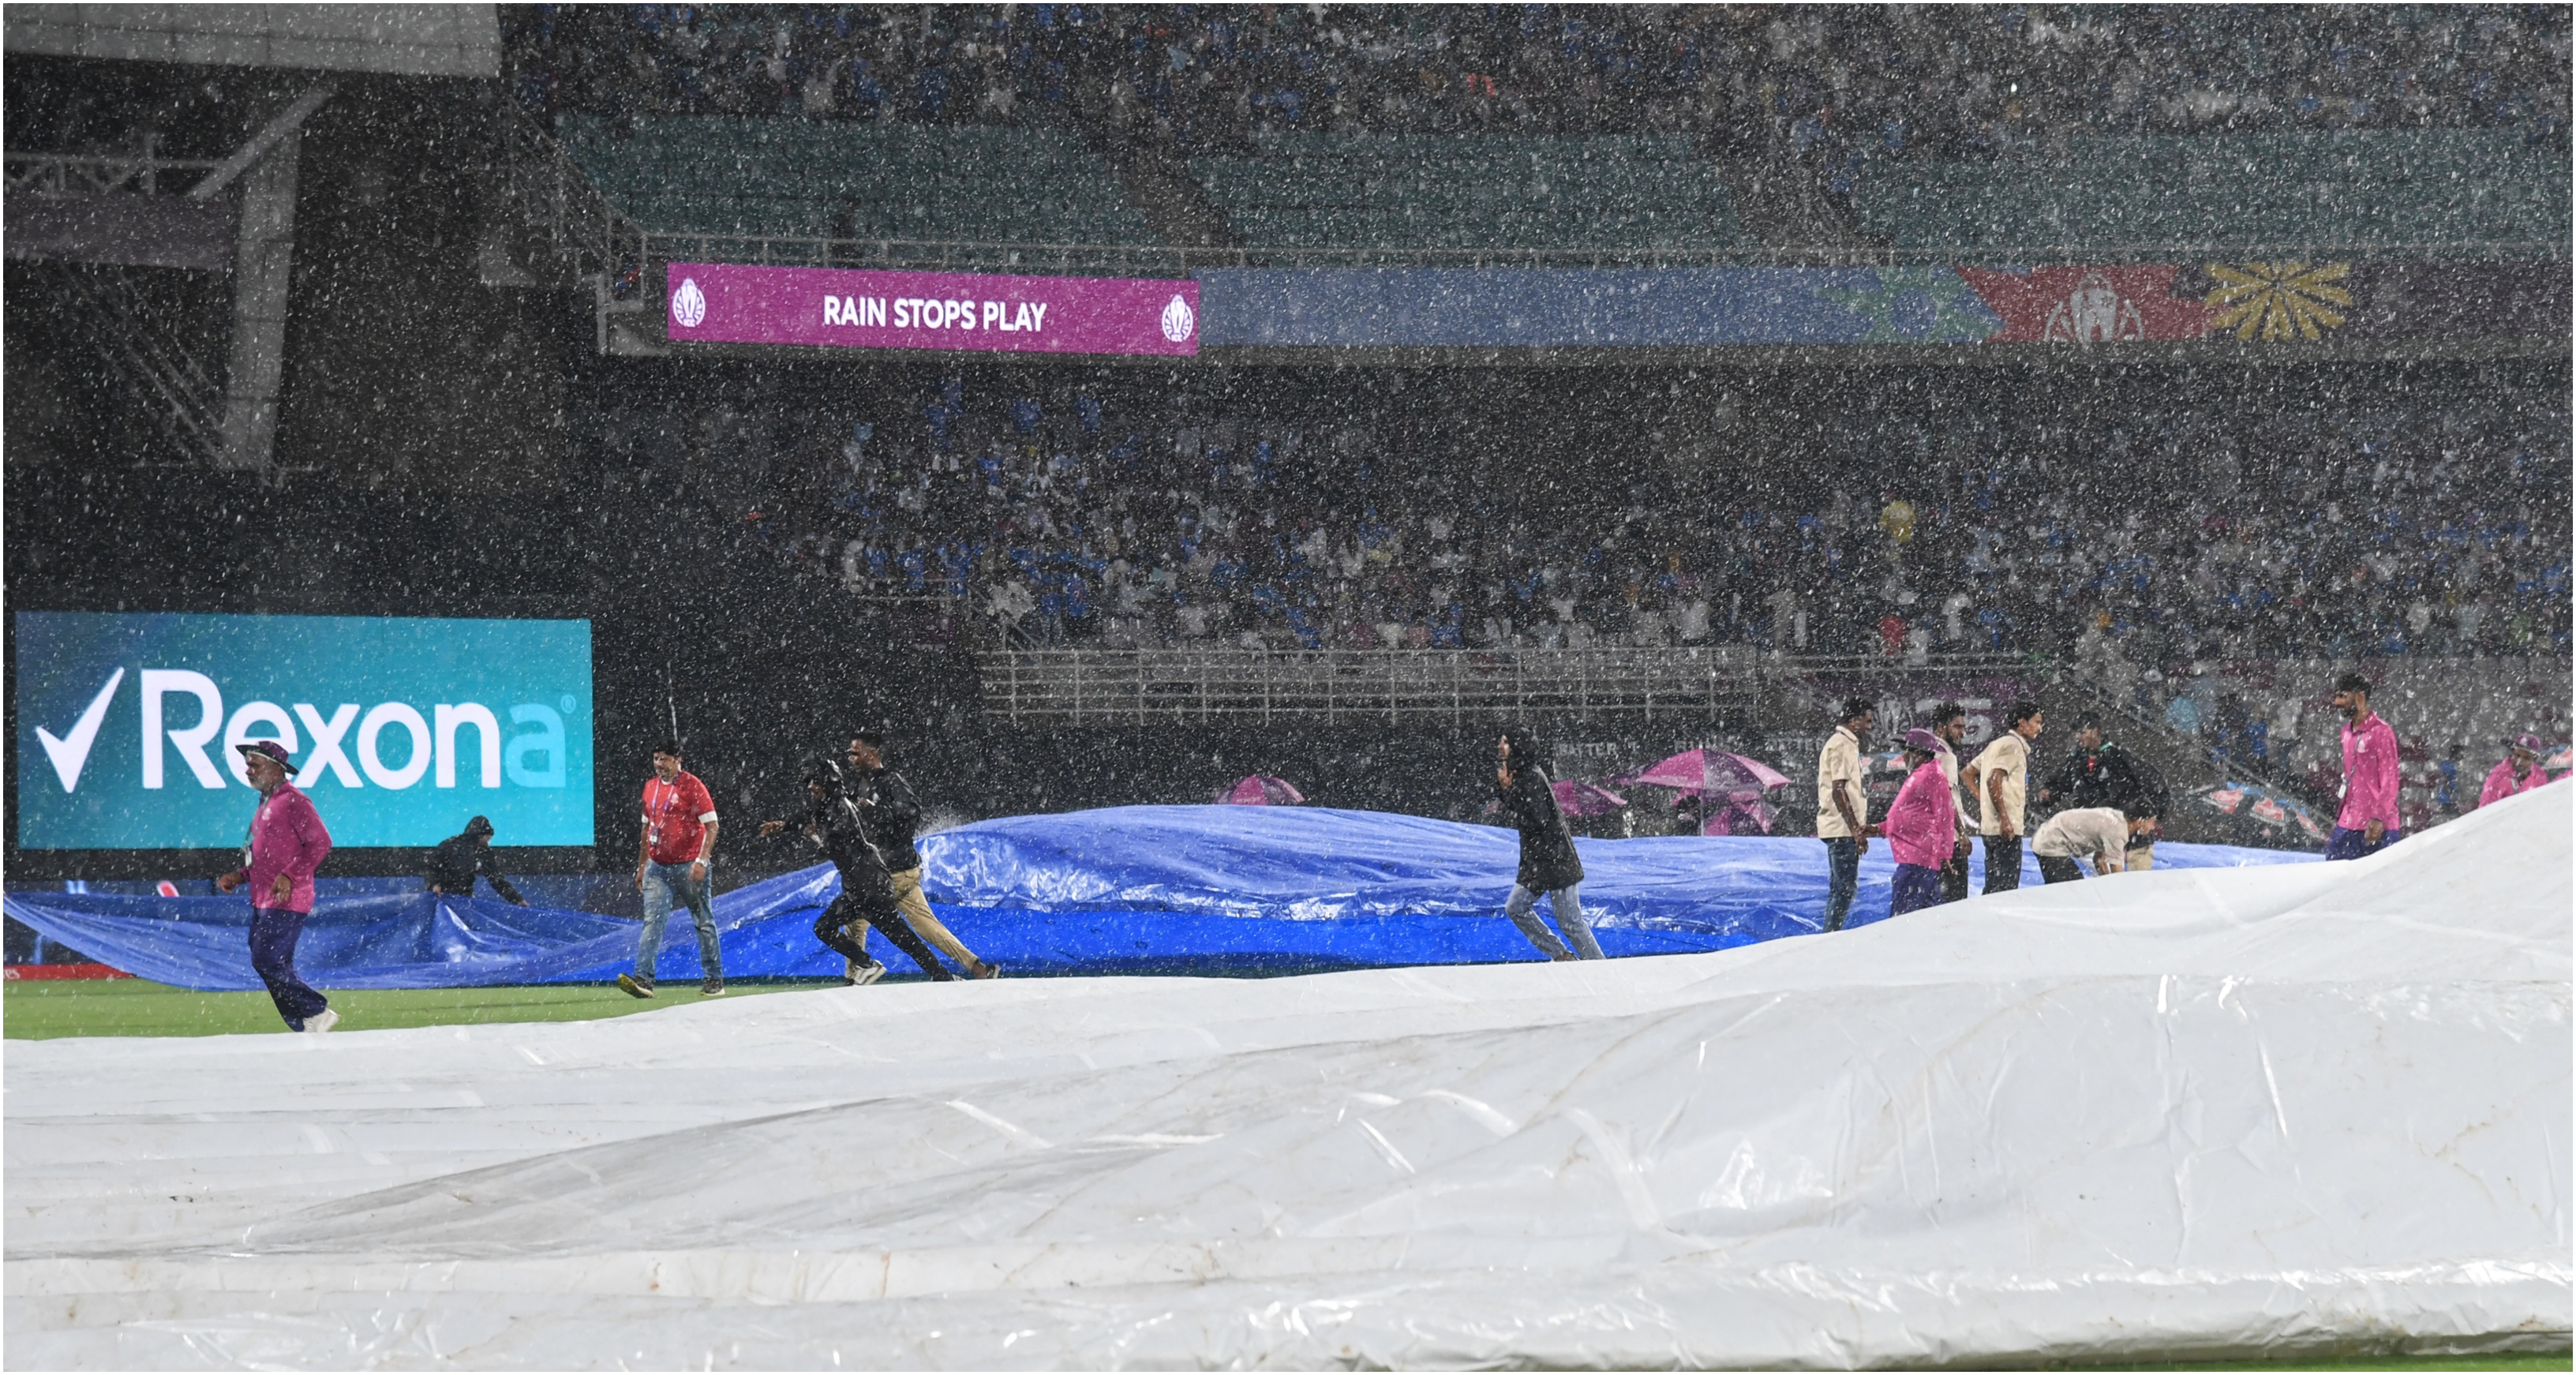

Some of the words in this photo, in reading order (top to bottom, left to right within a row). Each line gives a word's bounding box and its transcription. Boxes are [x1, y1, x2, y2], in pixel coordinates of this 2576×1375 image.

[824, 294, 886, 328] RAIN
[893, 298, 976, 330] STOPS
[983, 301, 1047, 332] PLAY
[141, 669, 567, 790] Rexona
